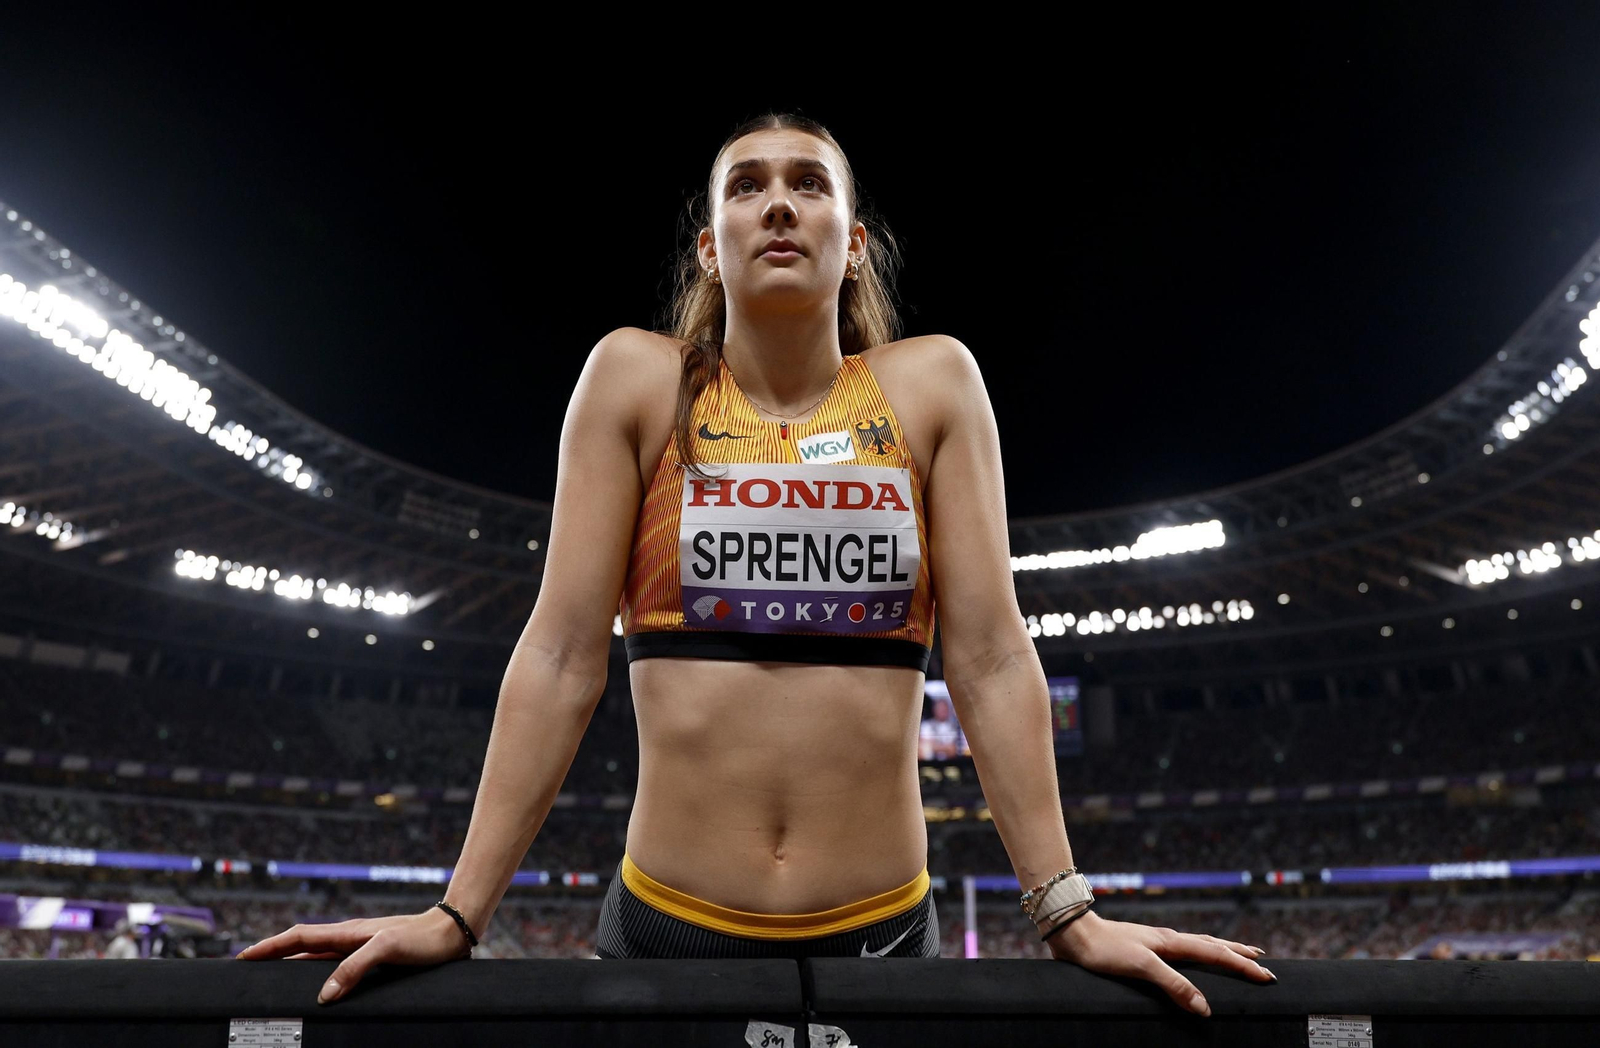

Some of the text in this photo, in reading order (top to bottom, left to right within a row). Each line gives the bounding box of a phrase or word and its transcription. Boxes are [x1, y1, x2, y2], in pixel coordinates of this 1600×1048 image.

[800, 437, 850, 460] WGV
[687, 478, 910, 512] HONDA
[691, 530, 909, 584] SPRENGEL
[872, 601, 904, 620] 25
